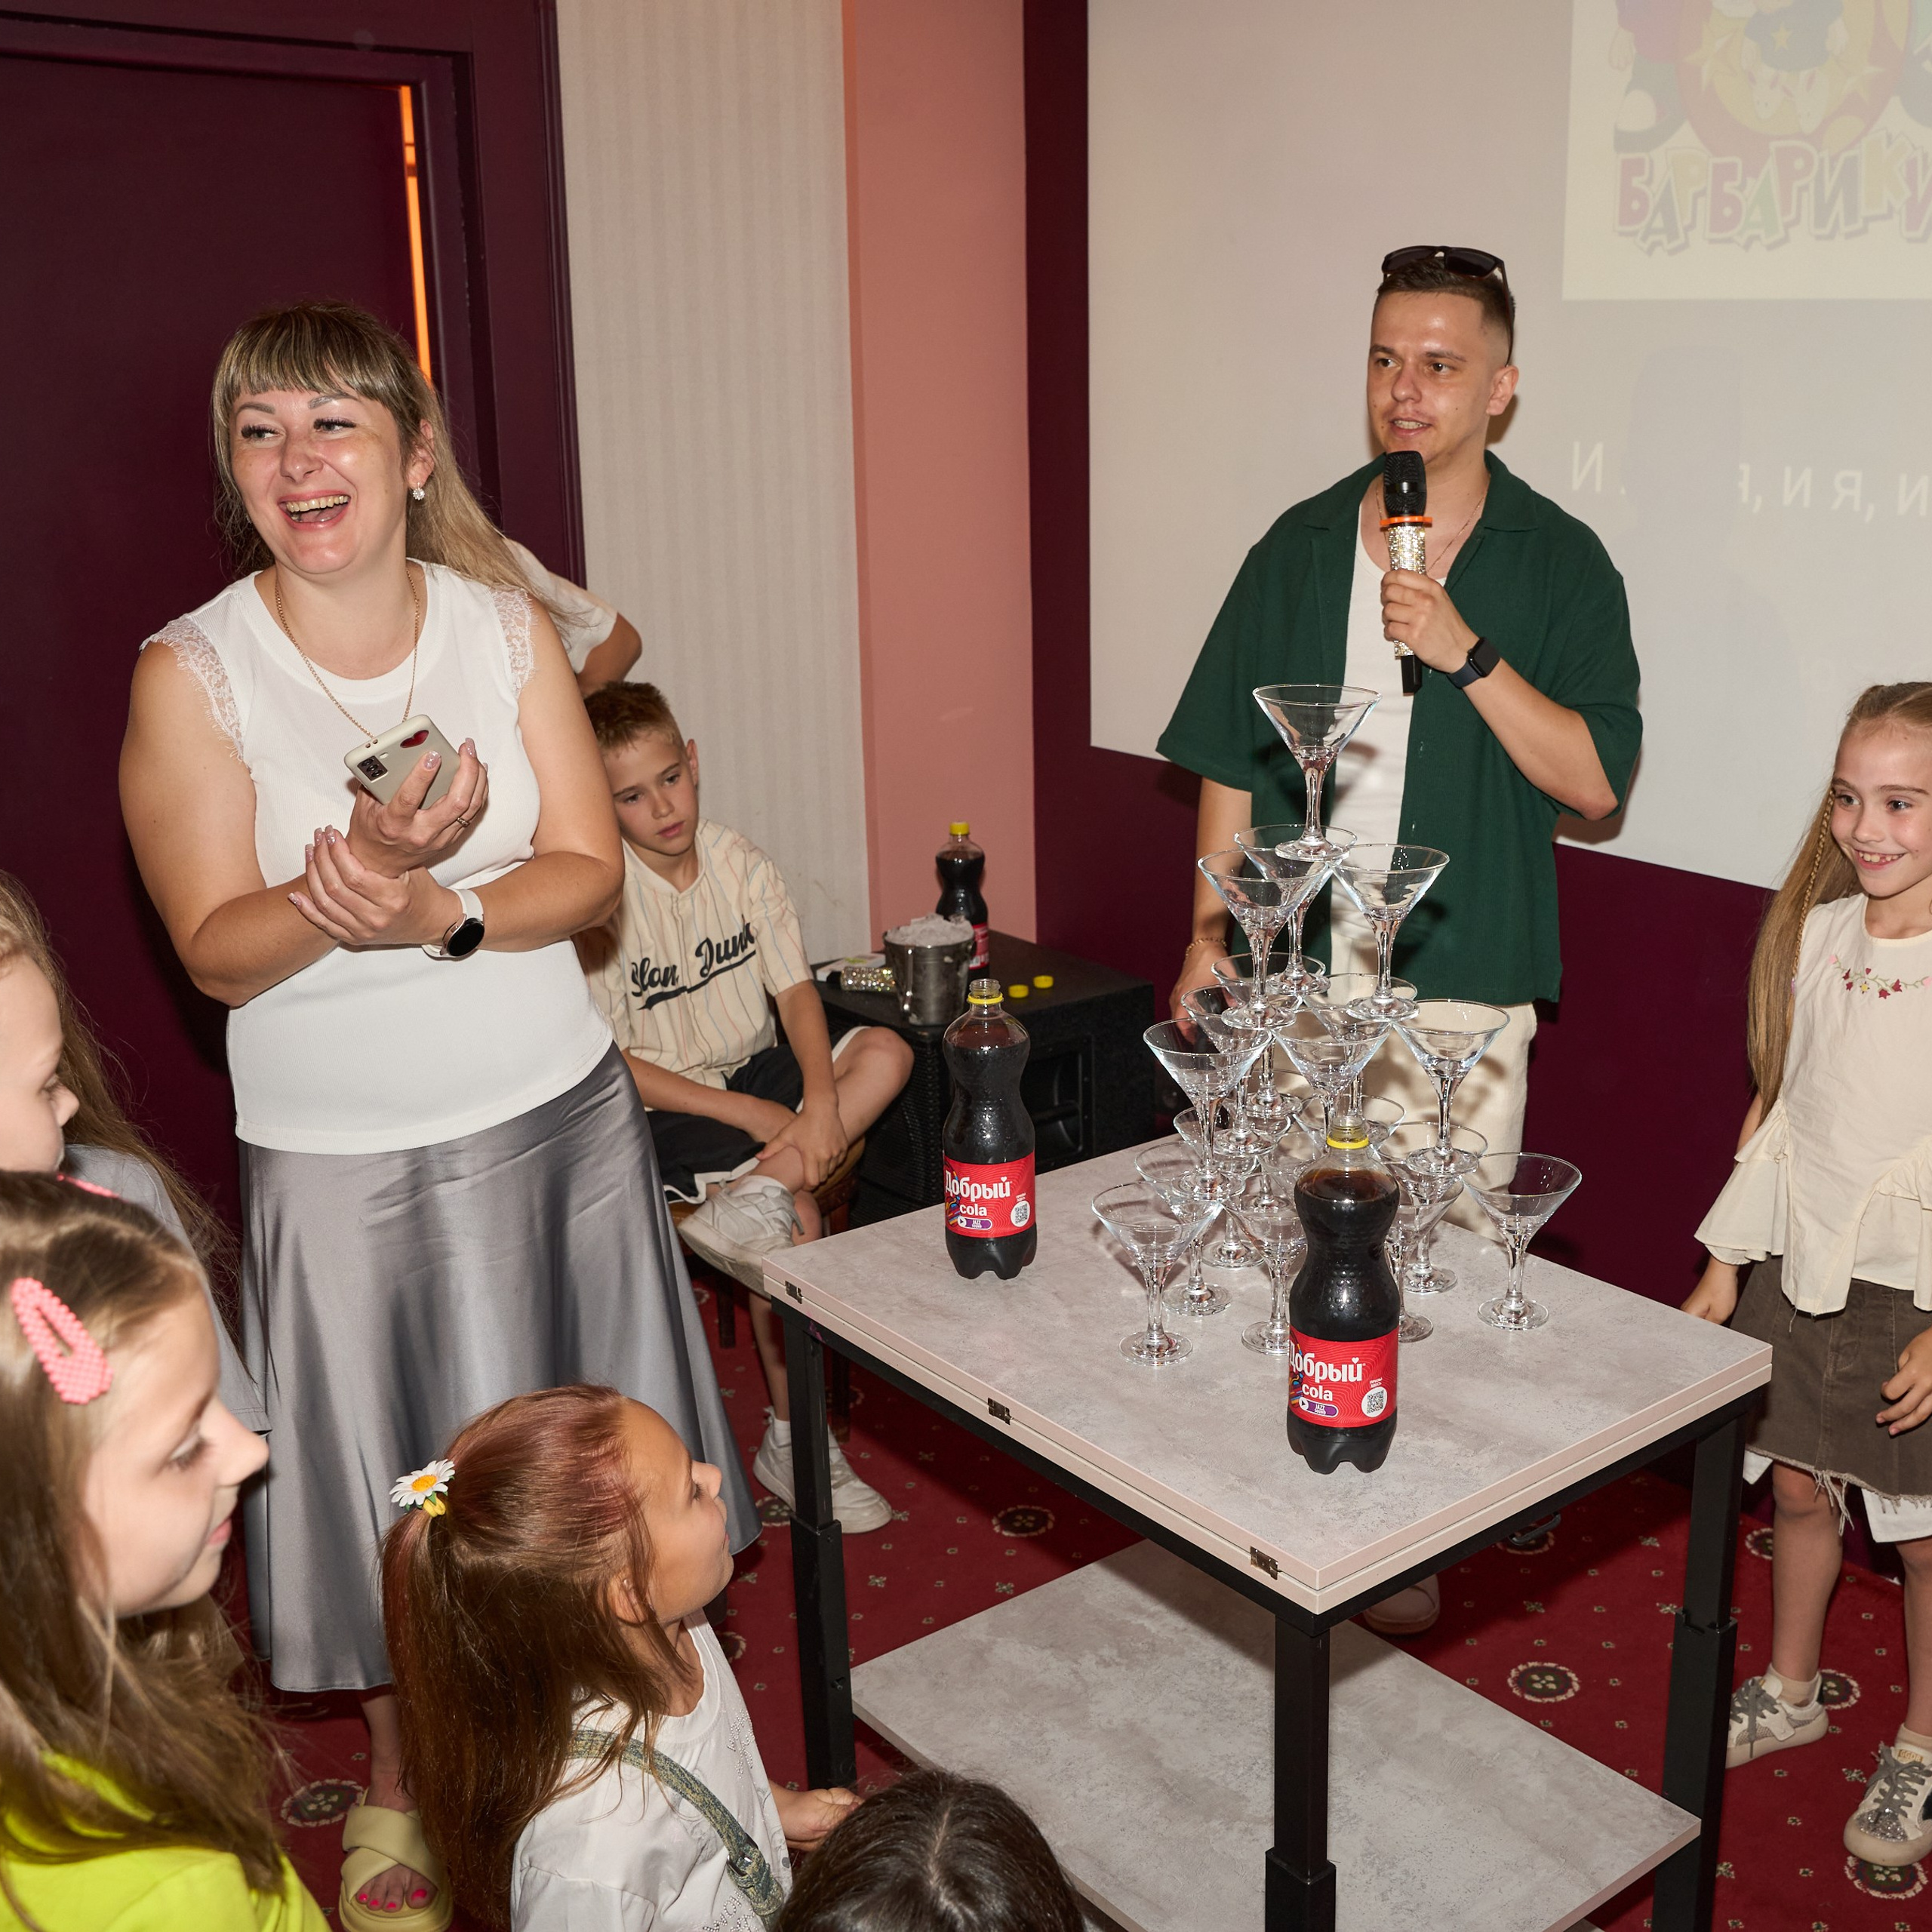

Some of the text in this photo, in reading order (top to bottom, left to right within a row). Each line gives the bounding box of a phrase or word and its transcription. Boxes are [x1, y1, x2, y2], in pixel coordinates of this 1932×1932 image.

[946, 1170, 1011, 1202] Добрый
[959, 1203, 987, 1217] cola
[1290, 1340, 1362, 1383] Добрый
[1302, 1383, 1333, 1401] cola
